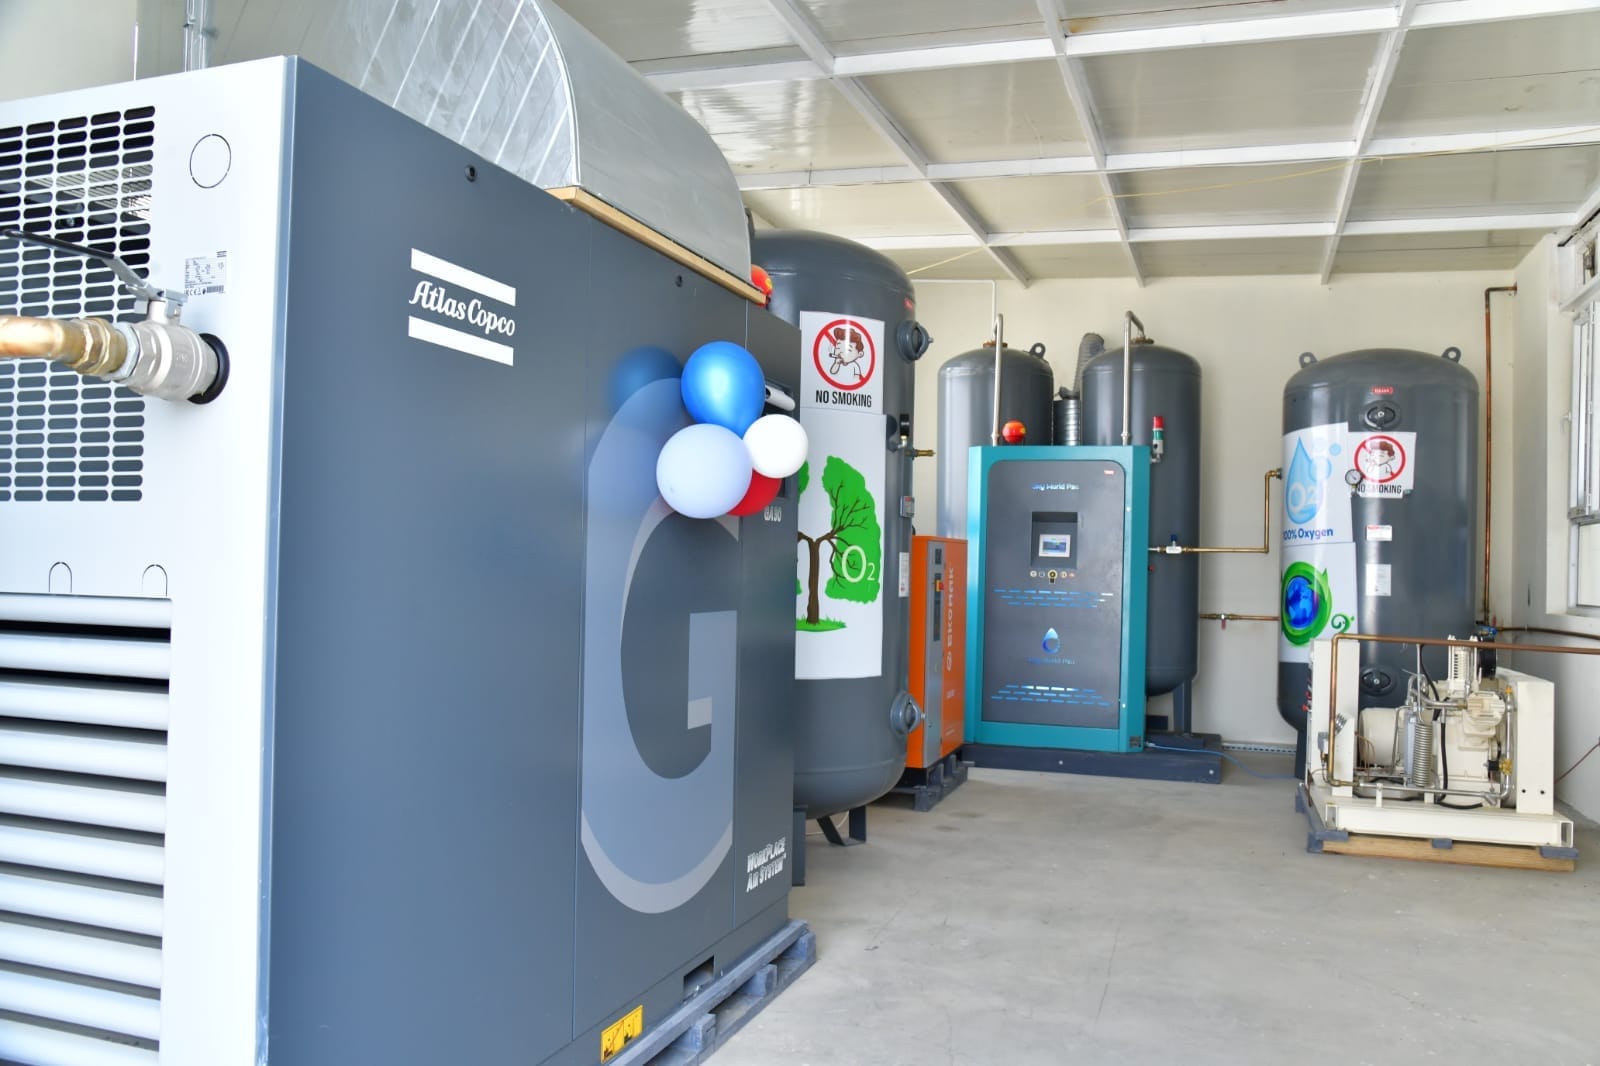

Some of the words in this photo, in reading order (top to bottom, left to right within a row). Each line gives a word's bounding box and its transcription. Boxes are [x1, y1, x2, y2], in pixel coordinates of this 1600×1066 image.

[408, 280, 467, 320] Atlas
[467, 298, 516, 336] Copco
[815, 389, 830, 404] NO
[832, 391, 873, 408] SMOKING
[1298, 527, 1334, 540] Oxygen
